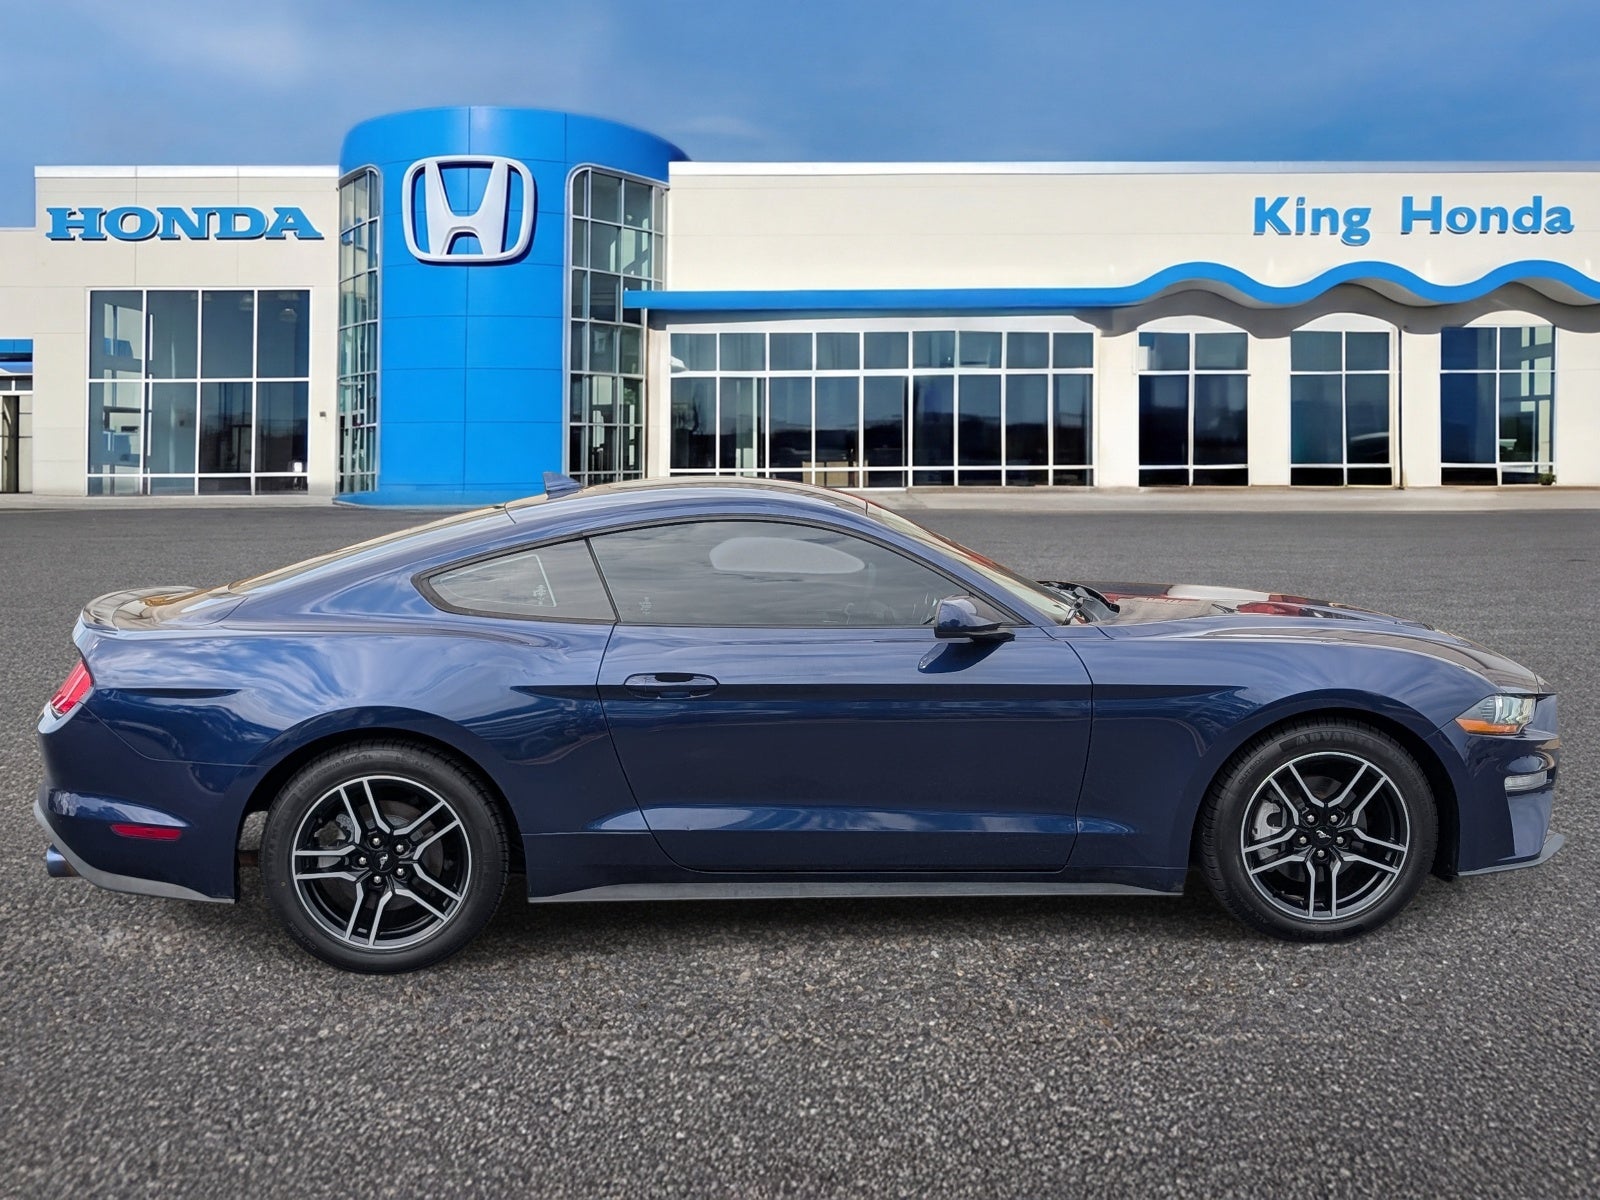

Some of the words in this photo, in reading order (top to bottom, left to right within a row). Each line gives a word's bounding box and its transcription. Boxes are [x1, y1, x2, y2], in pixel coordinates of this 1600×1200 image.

[46, 206, 325, 241] HONDA
[1253, 196, 1372, 246] King
[1400, 196, 1575, 235] Honda
